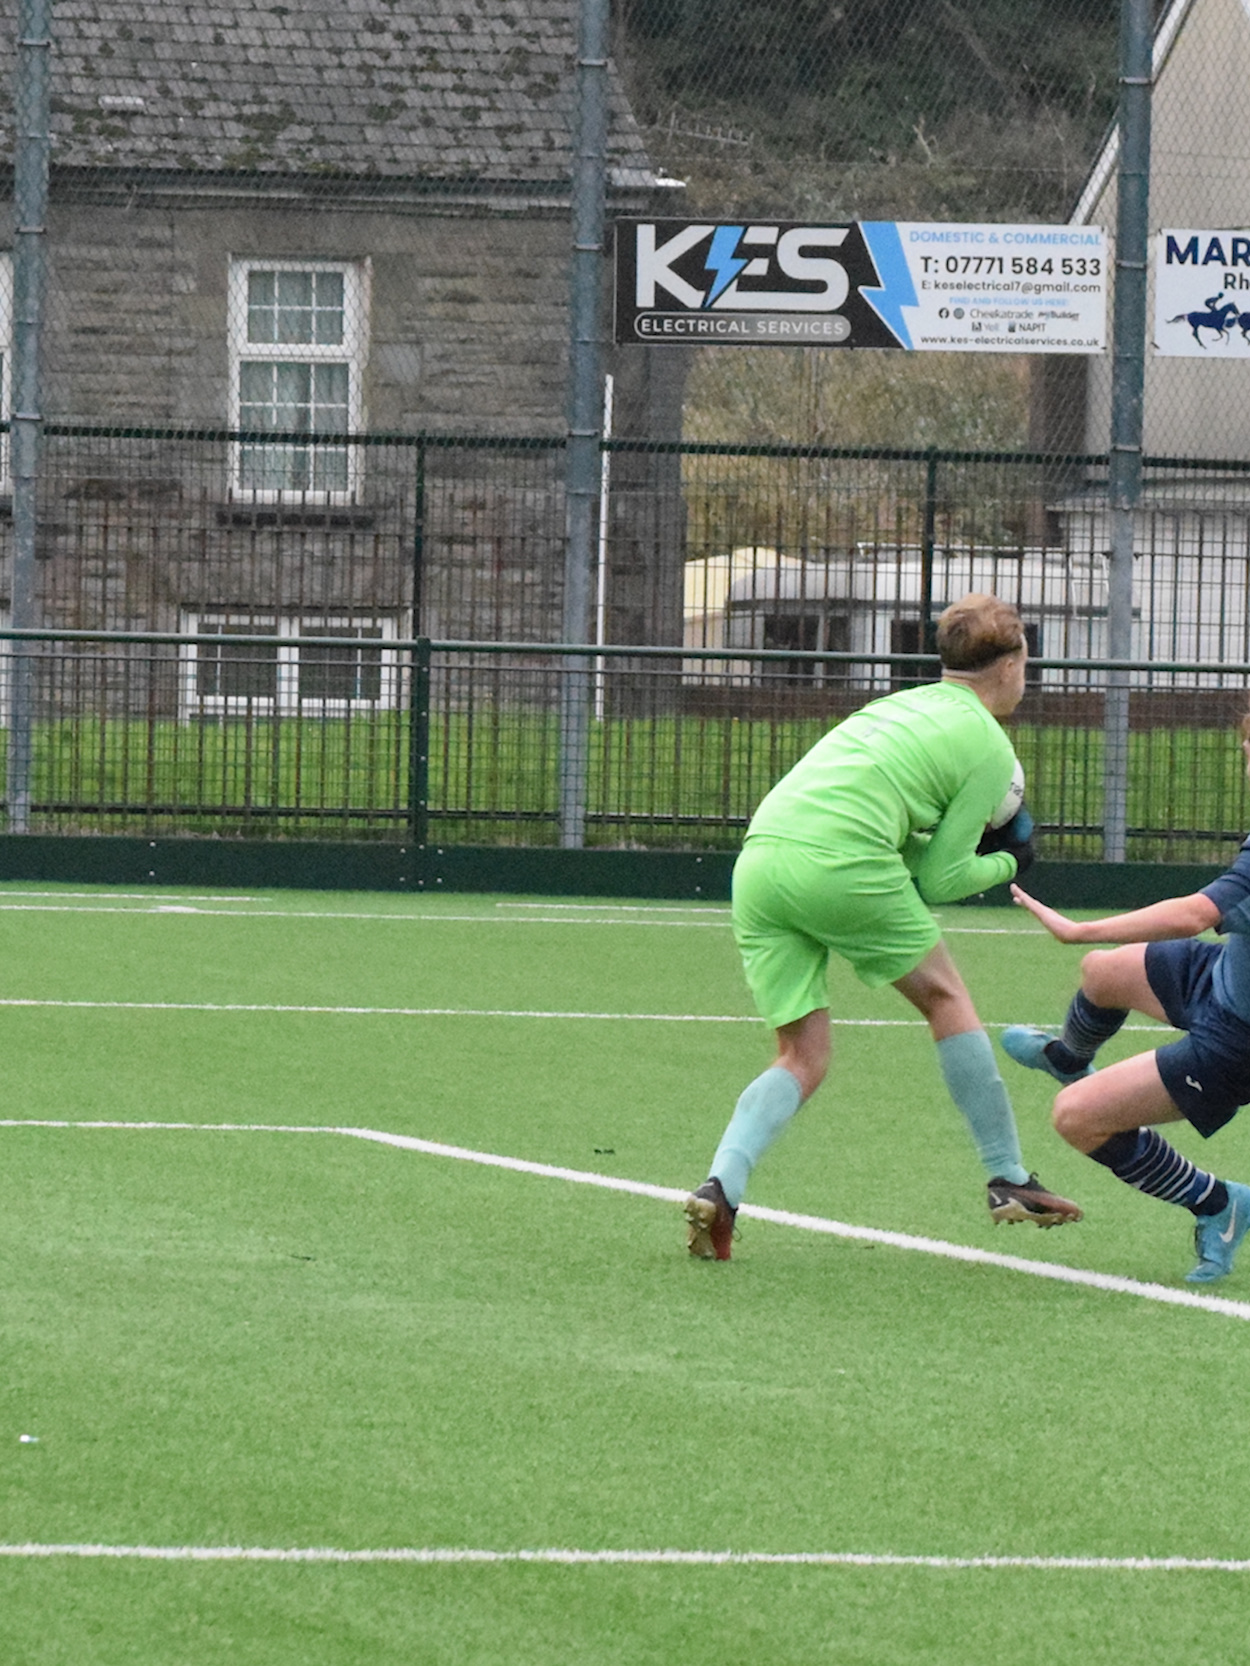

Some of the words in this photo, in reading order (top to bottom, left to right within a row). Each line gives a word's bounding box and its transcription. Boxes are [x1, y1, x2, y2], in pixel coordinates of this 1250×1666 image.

[910, 231, 984, 244] DOMESTIC
[989, 233, 999, 244] &
[1003, 232, 1101, 246] COMMERCIAL
[636, 224, 850, 311] KES
[920, 256, 939, 274] T:
[945, 256, 1004, 275] 07771
[1012, 257, 1054, 275] 584
[1061, 258, 1101, 276] 533
[921, 280, 932, 291] E:
[934, 280, 1101, 295] keselectrical7@gmail.com
[641, 318, 749, 333] ELECTRICAL
[757, 320, 844, 335] SERVICES
[1019, 323, 1047, 333] NAPIT
[921, 336, 1099, 348] www.kes-electricalservices.co.uk
